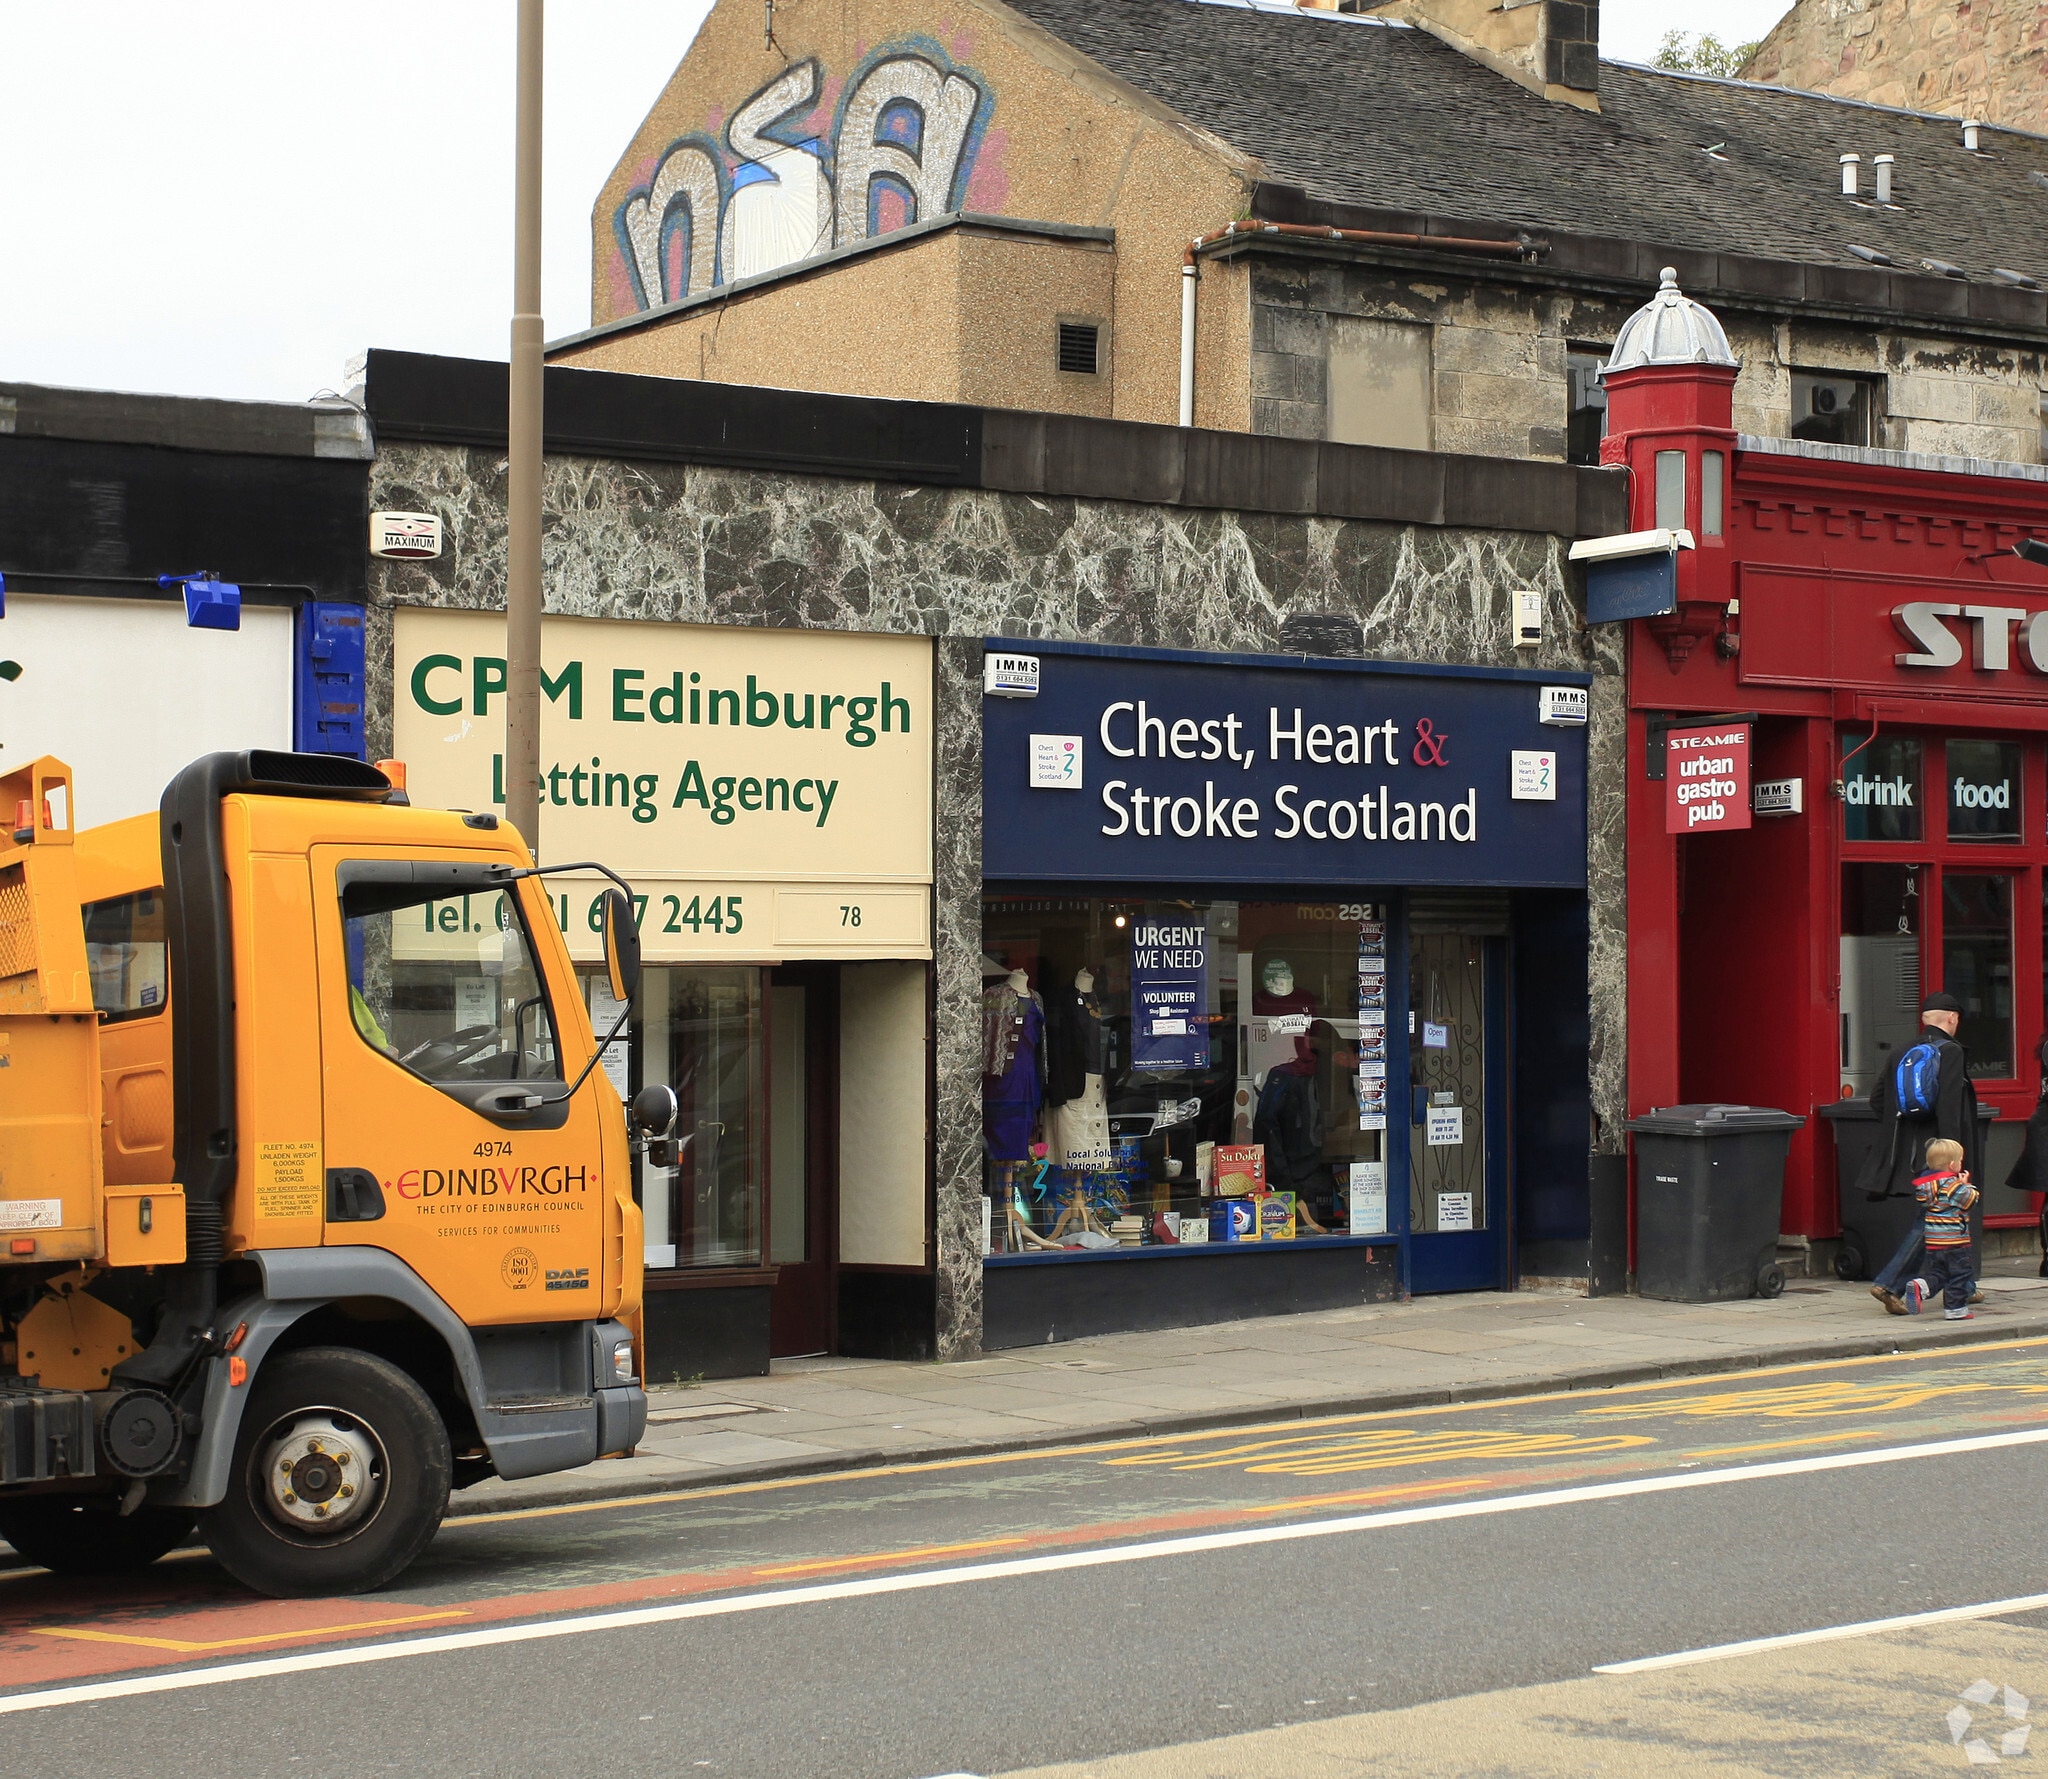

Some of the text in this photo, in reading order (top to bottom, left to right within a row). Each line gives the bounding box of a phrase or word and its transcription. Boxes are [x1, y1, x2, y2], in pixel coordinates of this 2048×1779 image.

[385, 537, 434, 548] MAXIMUM
[996, 659, 1038, 672] IMMS
[409, 653, 911, 748] CPM Edinburgh
[1552, 692, 1585, 703] IMMS
[1099, 700, 1449, 770] Chest, Heart &
[1669, 733, 1745, 750] STEAMIE
[1680, 755, 1734, 778] urban
[672, 760, 839, 828] Agency
[1677, 779, 1736, 805] gastro
[1756, 785, 1791, 796] IMMS
[1846, 773, 1913, 807] drink
[1954, 777, 2010, 809] food
[1101, 780, 1477, 843] Stroke Scotland
[1688, 804, 1725, 826] pub
[662, 894, 744, 935] 2445
[839, 906, 862, 928] 78
[1135, 927, 1205, 947] URGENT
[1135, 950, 1204, 969] WE NEED
[1143, 992, 1195, 1004] VOLUNTEER
[1428, 1028, 1443, 1037] Open
[473, 1142, 512, 1157] 4974
[1067, 1150, 1090, 1159] Local
[1221, 1151, 1260, 1161] Su Doku
[1066, 1162, 1104, 1170] National
[397, 1165, 586, 1199] EDINBVRGH
[6, 1202, 46, 1210] WARNING
[417, 1201, 584, 1214] THE CITY OF EDINBURGH COUNCIL
[438, 1224, 561, 1237] SERVICES FOR COMMUNITIES
[513, 1258, 528, 1266] ISO
[511, 1267, 528, 1276] 9001
[546, 1268, 589, 1279] DAF
